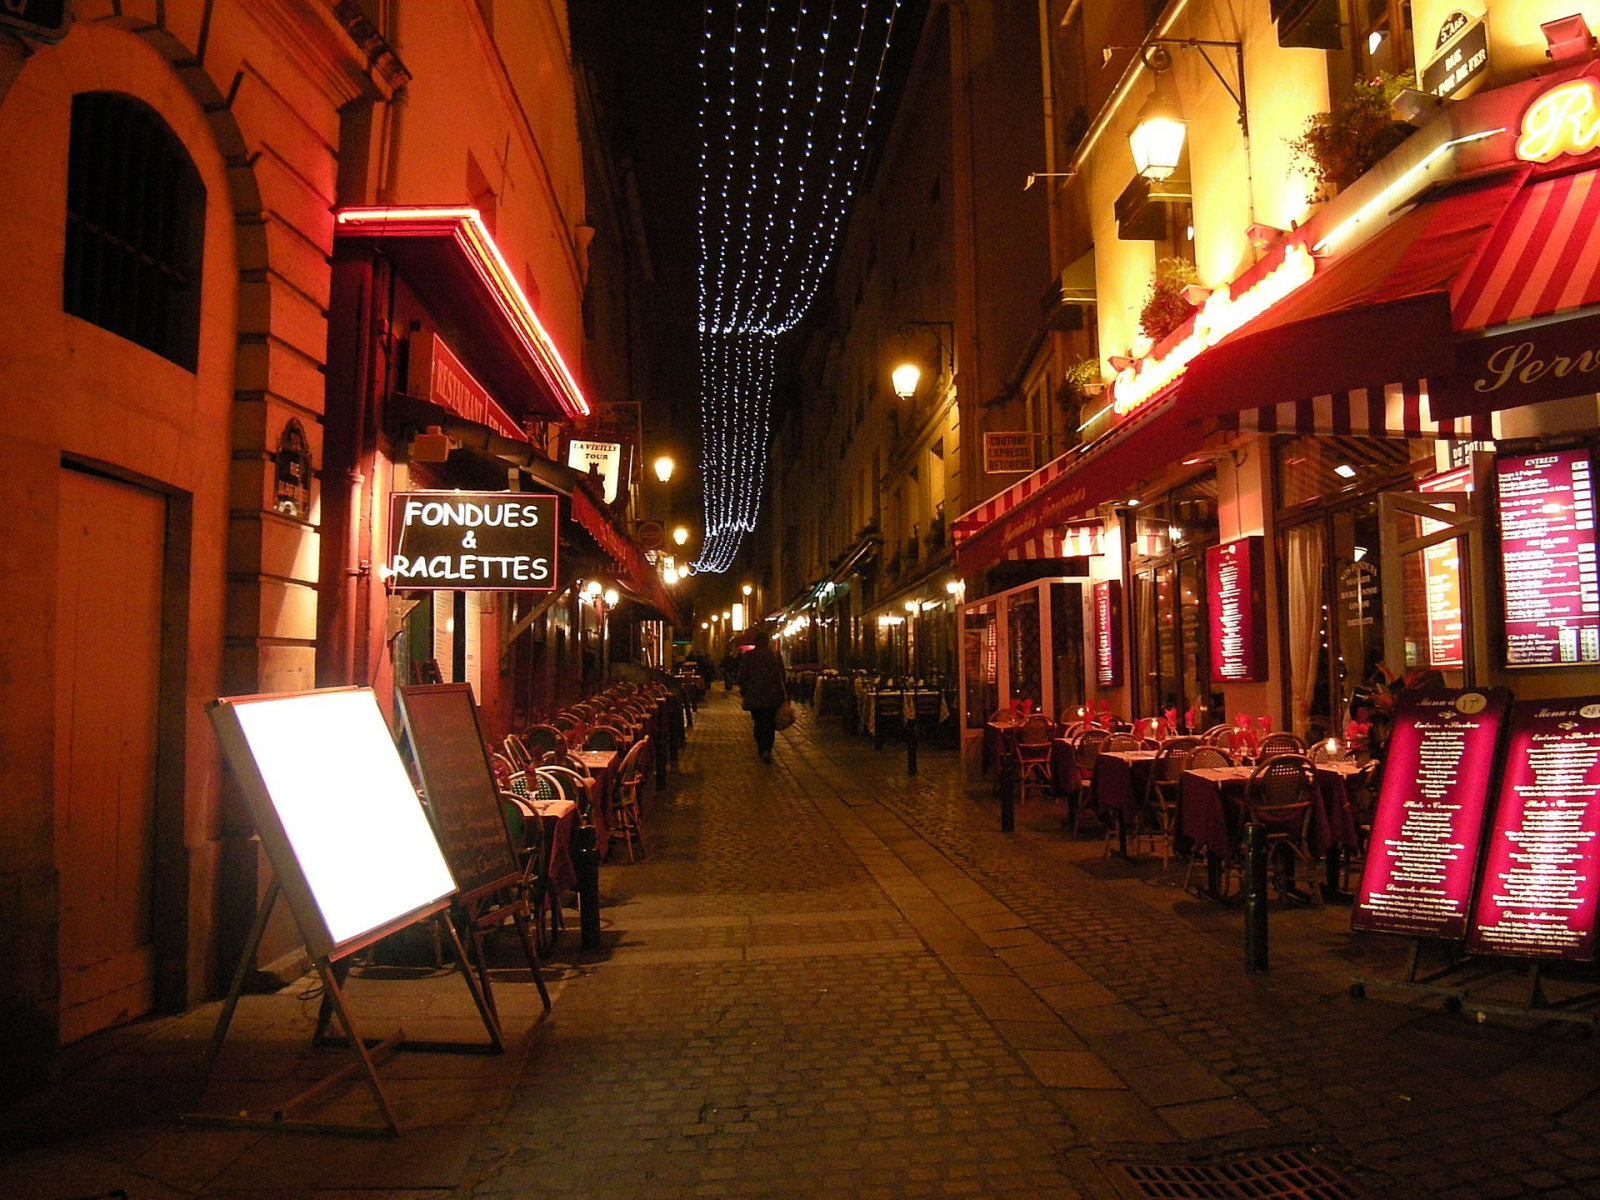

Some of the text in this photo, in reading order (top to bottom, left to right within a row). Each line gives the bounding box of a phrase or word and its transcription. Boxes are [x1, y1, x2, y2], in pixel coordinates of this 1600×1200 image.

[1445, 48, 1462, 72] RUE
[1456, 63, 1469, 83] DE
[1468, 48, 1486, 72] FER
[436, 359, 484, 425] RESTAURANT
[990, 435, 1027, 446] COUTURE
[405, 502, 538, 528] FONDUES
[462, 530, 477, 549] &
[392, 554, 549, 581] RACLETTES
